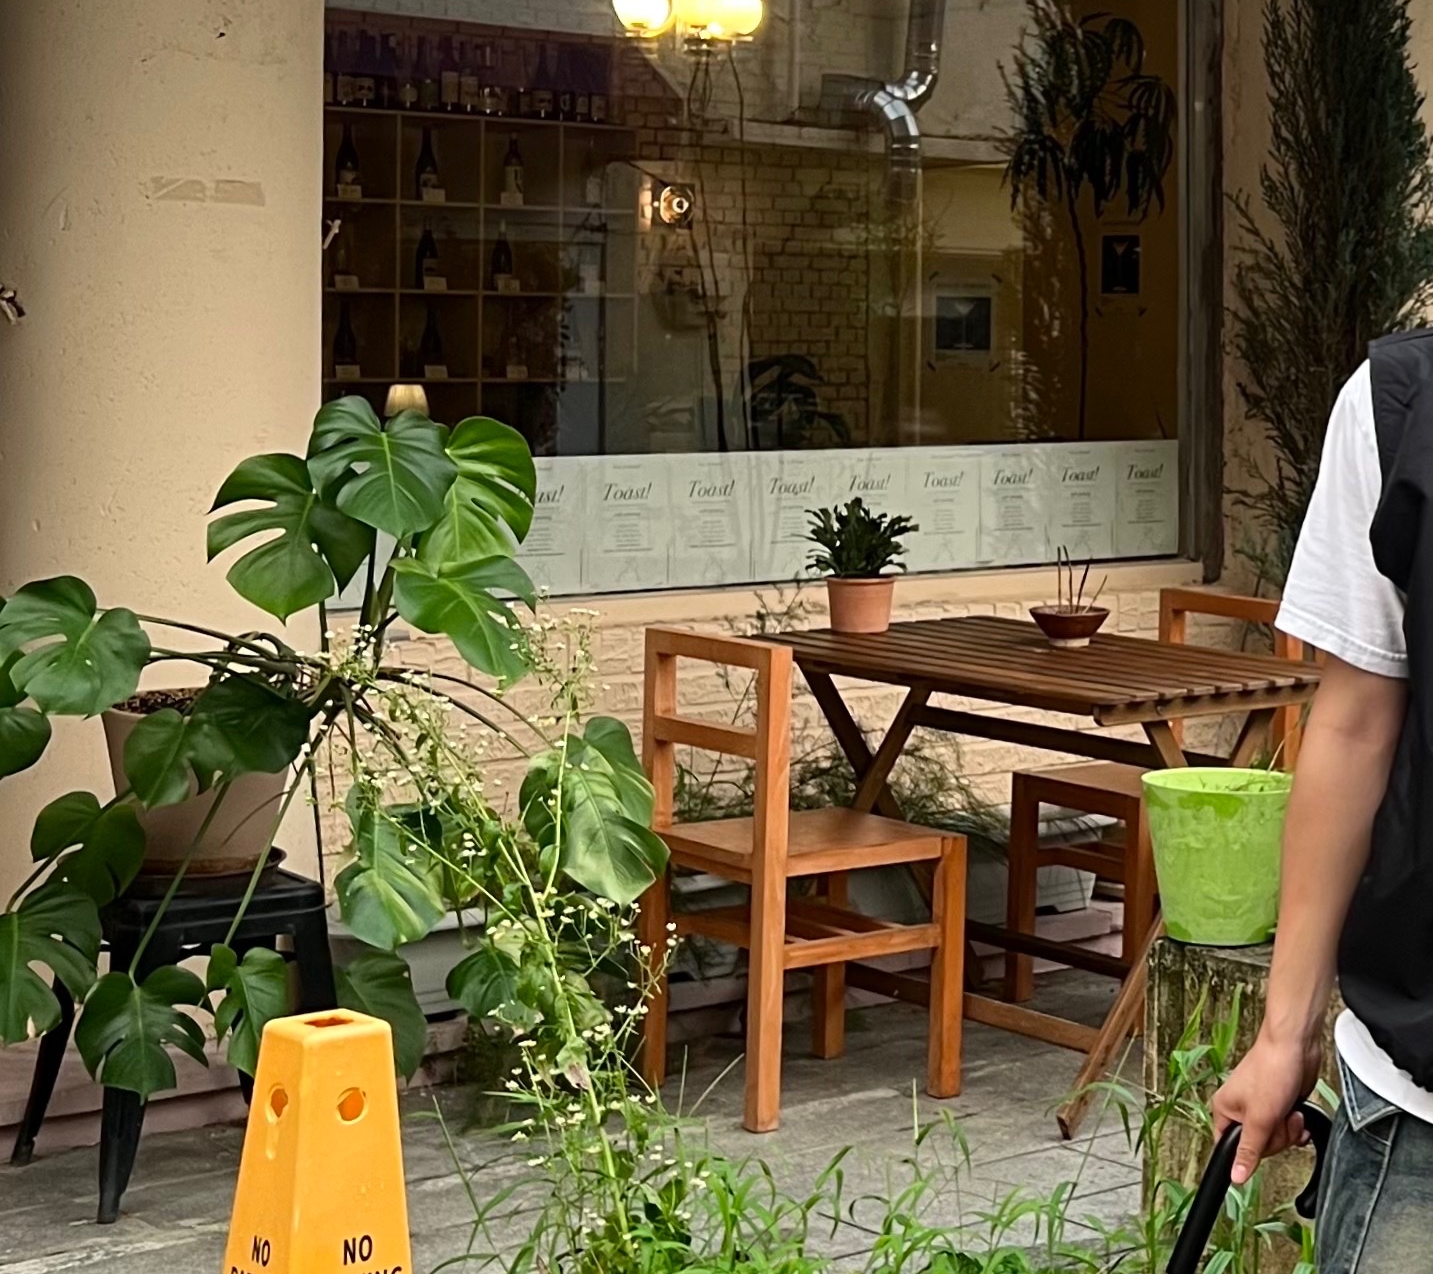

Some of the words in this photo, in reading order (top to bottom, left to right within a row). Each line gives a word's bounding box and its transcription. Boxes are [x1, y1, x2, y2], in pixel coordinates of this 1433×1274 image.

[923, 471, 964, 489] Toast!
[993, 468, 1034, 486] Toast!
[1061, 466, 1100, 483] Toast!
[1126, 463, 1164, 481] Toast!
[602, 482, 652, 502] Toast!
[688, 479, 735, 499] Toast!
[769, 476, 815, 496] Toast!
[849, 473, 891, 492] Toast!
[252, 1235, 271, 1268] NO
[343, 1234, 373, 1266] NO
